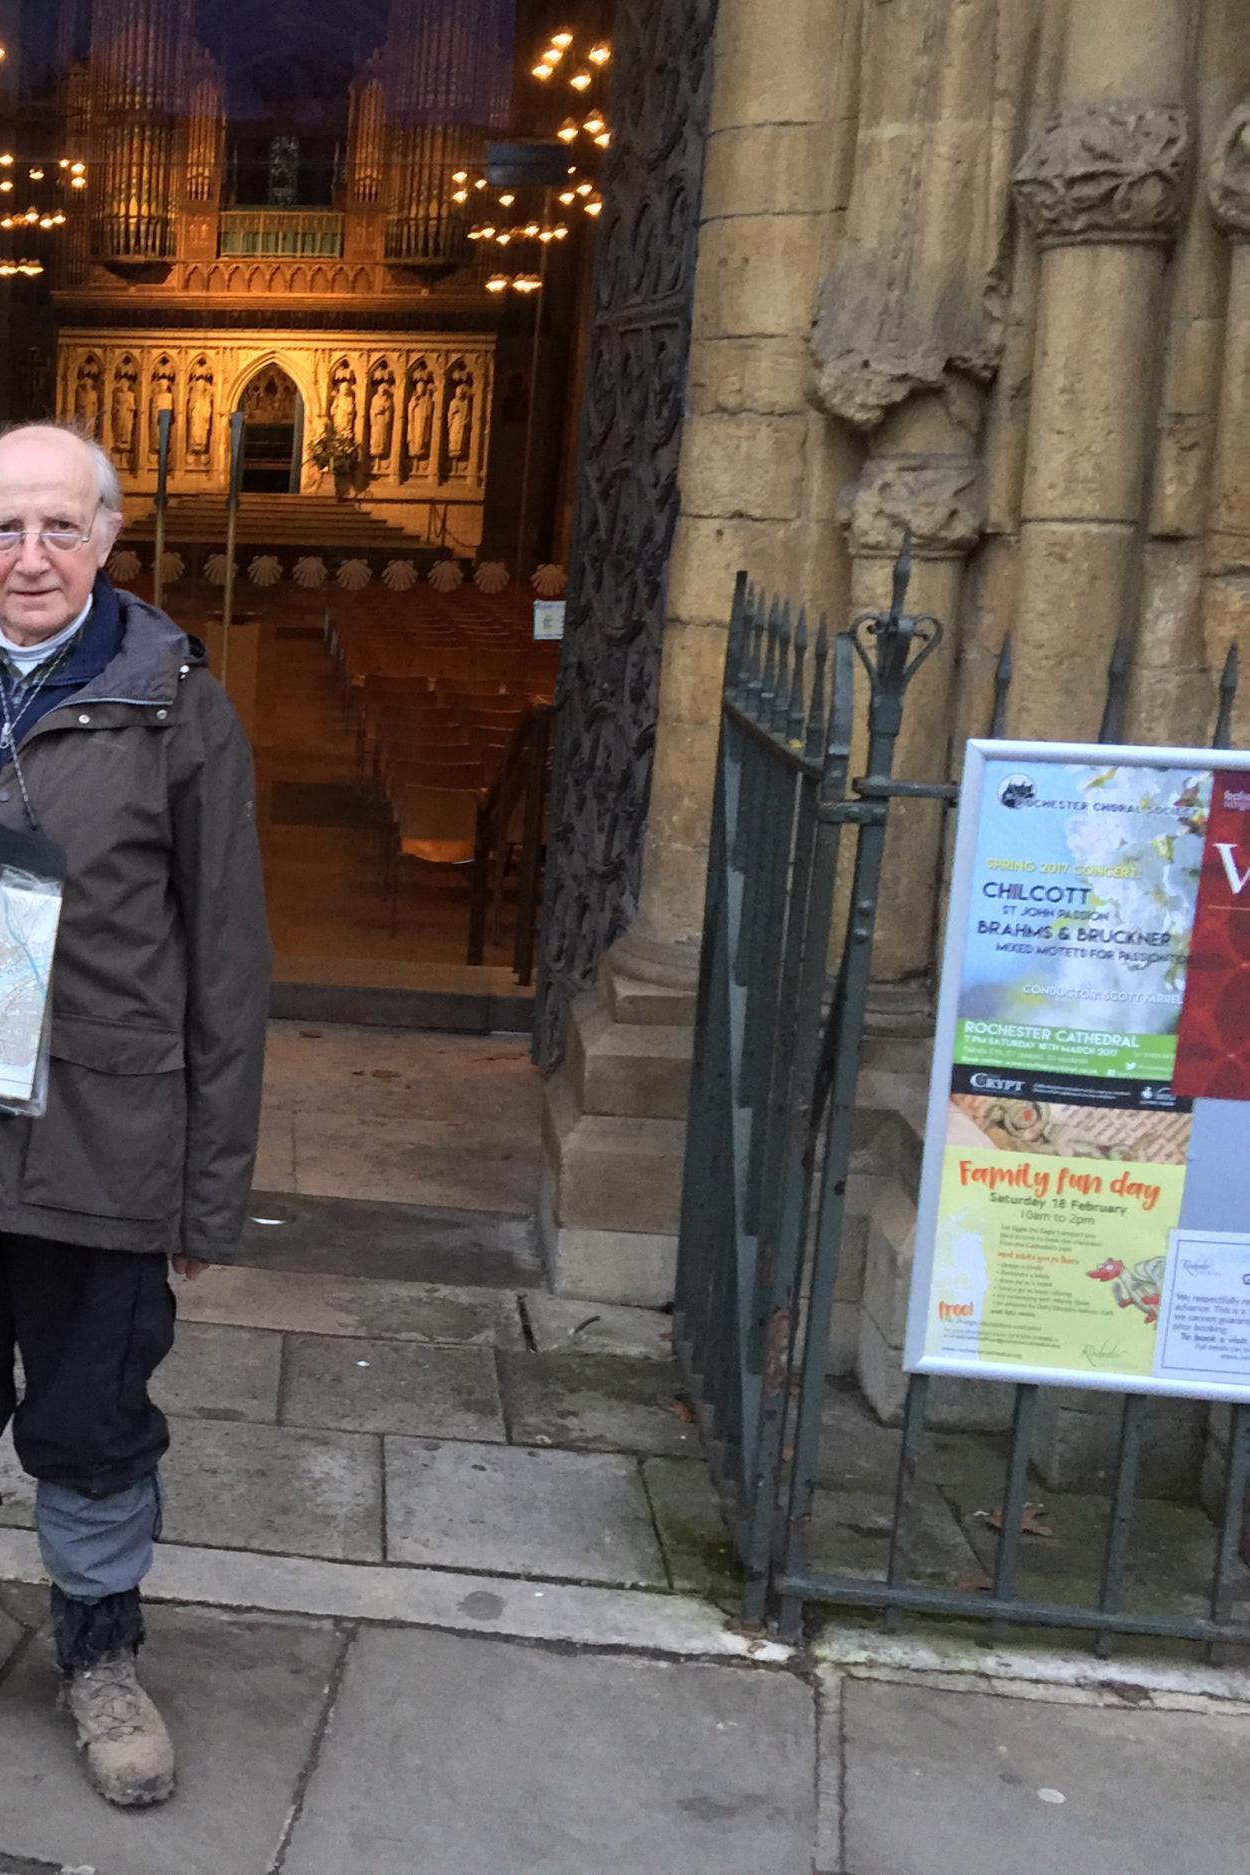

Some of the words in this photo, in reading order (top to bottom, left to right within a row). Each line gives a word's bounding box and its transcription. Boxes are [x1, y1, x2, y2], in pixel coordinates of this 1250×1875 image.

[1093, 802, 1142, 814] CHORAL
[986, 859, 1036, 873] SPRING
[1041, 864, 1070, 875] 2017
[1074, 865, 1136, 879] CONCERT
[982, 882, 1092, 905] CHILCOTT
[1002, 905, 1017, 915] ST
[1020, 907, 1055, 918] JOHN
[1057, 909, 1109, 921] PASSION
[977, 920, 1053, 940] BRAHMS
[1058, 927, 1070, 941] &
[1077, 928, 1172, 946] BRUCKNER
[1037, 946, 1087, 958] MOTETS
[1090, 948, 1114, 960] FOR
[964, 1021, 1050, 1040] ROCHESTER
[1055, 1030, 1140, 1048] CATHEDRAL
[964, 1035, 970, 1043] 7
[989, 1037, 1035, 1049] SATURDAY
[1061, 1043, 1095, 1055] MARCH
[1097, 1048, 1118, 1057] 2017
[958, 1161, 1049, 1198] Family
[1057, 1167, 1103, 1195] fun
[1110, 1171, 1161, 1211] day
[990, 1192, 1046, 1209] Saturday
[1052, 1199, 1066, 1209] 18
[1071, 1200, 1128, 1215] February
[1021, 1210, 1050, 1221] 10am
[1054, 1213, 1066, 1223] to
[1069, 1214, 1095, 1226] 2pm
